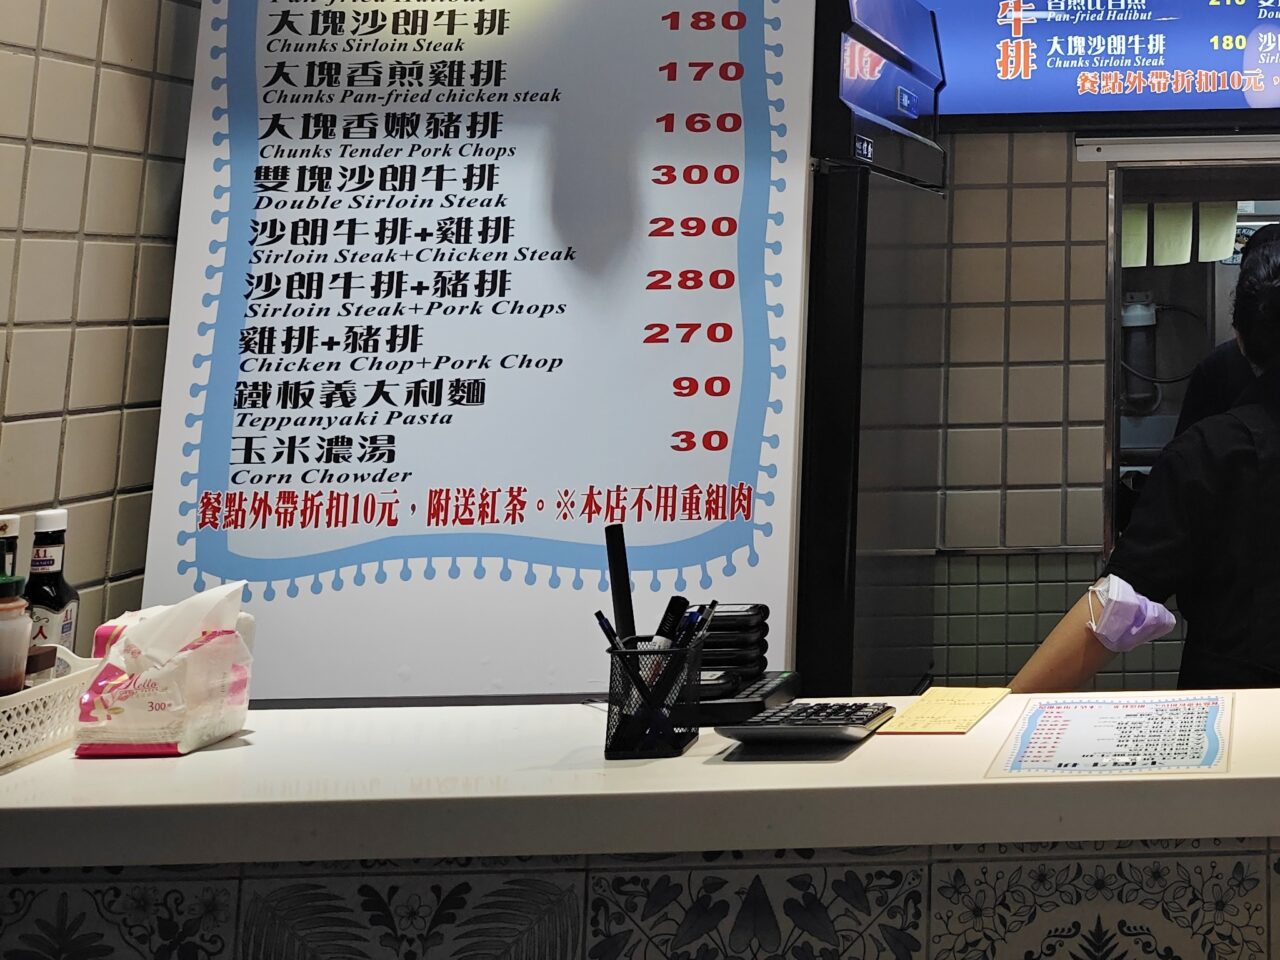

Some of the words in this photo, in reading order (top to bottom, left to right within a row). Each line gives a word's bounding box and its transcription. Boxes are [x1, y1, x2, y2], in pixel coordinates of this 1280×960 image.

[266, 8, 511, 36] 大塊沙朗牛排
[661, 11, 747, 31] 180
[1047, 11, 1104, 24] Pan-fried
[1106, 10, 1152, 21] Halibut
[266, 39, 338, 53] Chunks
[342, 39, 408, 53] Sirloin
[413, 38, 465, 52] Steak
[1046, 34, 1166, 57] 大塊沙朗牛排
[1209, 35, 1247, 50] 180
[1046, 57, 1090, 69] Chunks
[1091, 56, 1132, 68] Sirloin
[1133, 55, 1166, 67] Steak
[261, 59, 507, 88] 大塊香煎雞排
[658, 61, 745, 81] 170
[262, 90, 334, 104] Chunks
[339, 90, 431, 107] Pan-fried
[436, 89, 509, 103] chicken
[513, 88, 562, 102] steak
[258, 111, 504, 140] 大塊香嫩豬排
[655, 113, 742, 133] 160
[259, 144, 332, 160] Chunks
[338, 144, 403, 159] Tender
[408, 143, 453, 158] Pork
[458, 143, 517, 161] Chops
[252, 163, 500, 194] 雙塊沙朗牛排
[651, 164, 740, 185] 300
[252, 195, 343, 210] Double
[347, 194, 434, 209] Sirloin
[439, 193, 508, 209] Steak
[248, 215, 515, 247] 沙朗牛排+雞排
[647, 216, 738, 237] 290
[248, 250, 330, 265] Sirloin
[334, 248, 510, 264] Steak+Chicken
[513, 246, 577, 262] Steak
[242, 269, 512, 301] 沙朗牛排+豬排
[645, 269, 735, 290] 280
[243, 303, 331, 318] Sirloin
[337, 301, 485, 317] Steak+Pork
[490, 300, 567, 319] Chops
[238, 324, 424, 356] 雞排+豬排
[643, 322, 733, 343] 270
[239, 357, 342, 373] Chicken
[349, 355, 493, 375] Chop+Pork
[499, 354, 564, 372] Chop
[232, 378, 486, 410] 鐵板義大利麵
[672, 376, 731, 397] 90
[235, 412, 378, 431] Teppanyaki
[383, 410, 454, 426] Pasta
[229, 434, 396, 465] 玉米濃湯
[670, 430, 729, 452] 30
[231, 469, 292, 485] Corn
[299, 468, 413, 484] Chowder
